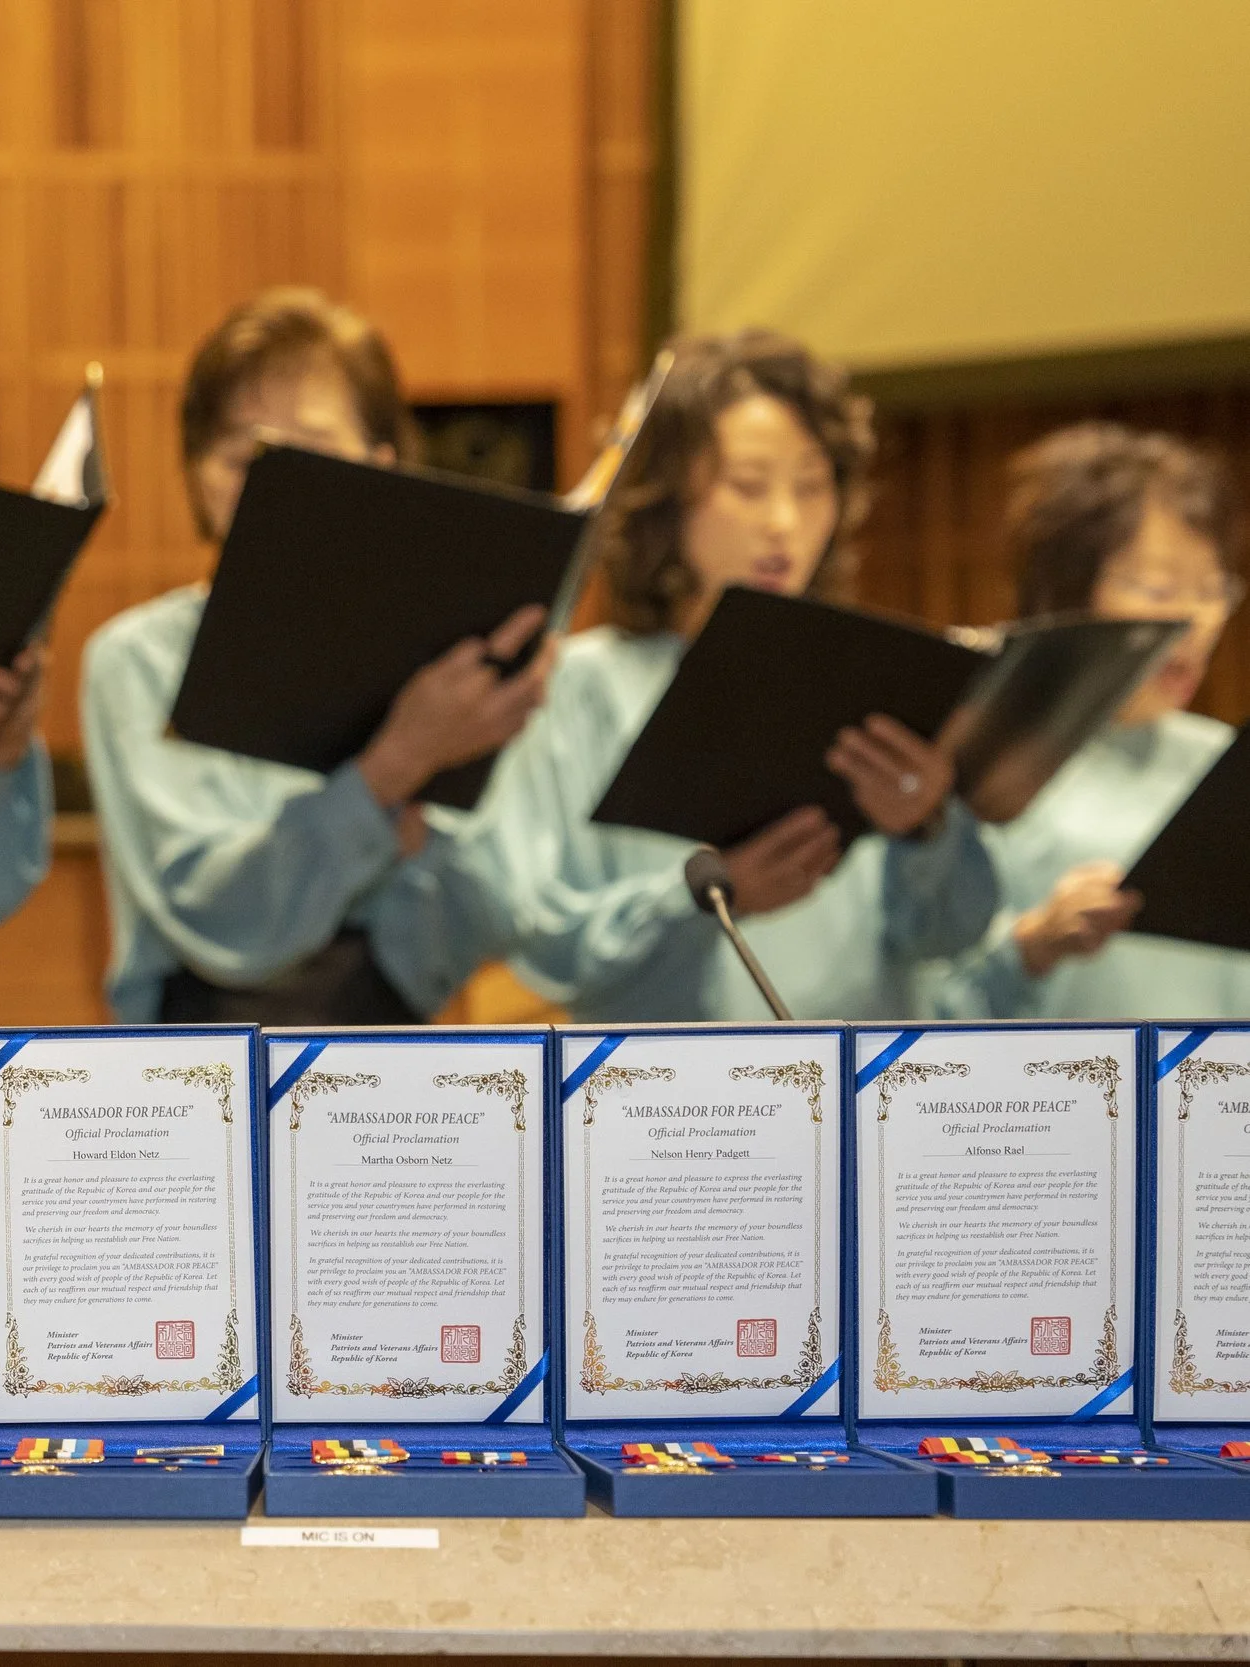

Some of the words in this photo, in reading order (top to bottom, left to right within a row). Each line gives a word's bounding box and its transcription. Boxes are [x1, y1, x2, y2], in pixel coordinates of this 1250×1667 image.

[711, 1104, 734, 1117] FOR
[1005, 1100, 1029, 1113] FOR
[125, 1106, 148, 1118] FOR
[415, 1112, 438, 1124] FOR
[648, 1127, 685, 1140] Official
[688, 1126, 755, 1137] Proclamation
[942, 1123, 979, 1136] Official
[982, 1122, 1050, 1133] Proclamation
[65, 1128, 101, 1141] Official
[104, 1127, 169, 1138] Proclamation
[353, 1133, 389, 1146] Official
[392, 1133, 459, 1144] Proclamation
[73, 1151, 107, 1159] Howard
[110, 1150, 136, 1158] Eldon
[139, 1150, 159, 1158] Netz
[651, 1150, 682, 1158] Nelson
[685, 1149, 712, 1159] Henry
[716, 1149, 749, 1159] Padgett
[965, 1146, 1001, 1155] Alfonso
[1004, 1146, 1024, 1154] Rael
[361, 1155, 393, 1164] Martha
[396, 1156, 428, 1164] Osborn
[432, 1156, 452, 1164] Netz
[100, 1175, 128, 1183] pleasure
[178, 1174, 215, 1182] everlasting
[21, 1187, 53, 1196] gratitude
[55, 1186, 64, 1195] of
[107, 1186, 115, 1195] of
[168, 1185, 190, 1194] people
[191, 1184, 202, 1194] for
[88, 1197, 127, 1206] countrymen
[145, 1196, 178, 1205] performed
[188, 1196, 216, 1204] restoring
[82, 1208, 108, 1217] freedom
[127, 1341, 153, 1349] Affairs
[708, 1338, 734, 1347] Affairs
[1002, 1336, 1028, 1345] Affairs
[1216, 1340, 1246, 1348] Patriots
[412, 1344, 438, 1352] Affairs
[919, 1348, 950, 1357] Republic
[953, 1348, 963, 1357] of
[47, 1352, 78, 1361] Republic
[80, 1352, 90, 1361] of
[331, 1354, 362, 1363] Republic
[364, 1354, 374, 1363] of
[626, 1350, 657, 1359] Republic
[660, 1350, 670, 1359] of
[1215, 1351, 1250, 1360] Republic
[302, 1532, 330, 1542] MIC
[335, 1532, 348, 1542] IS
[352, 1532, 374, 1542] ON
